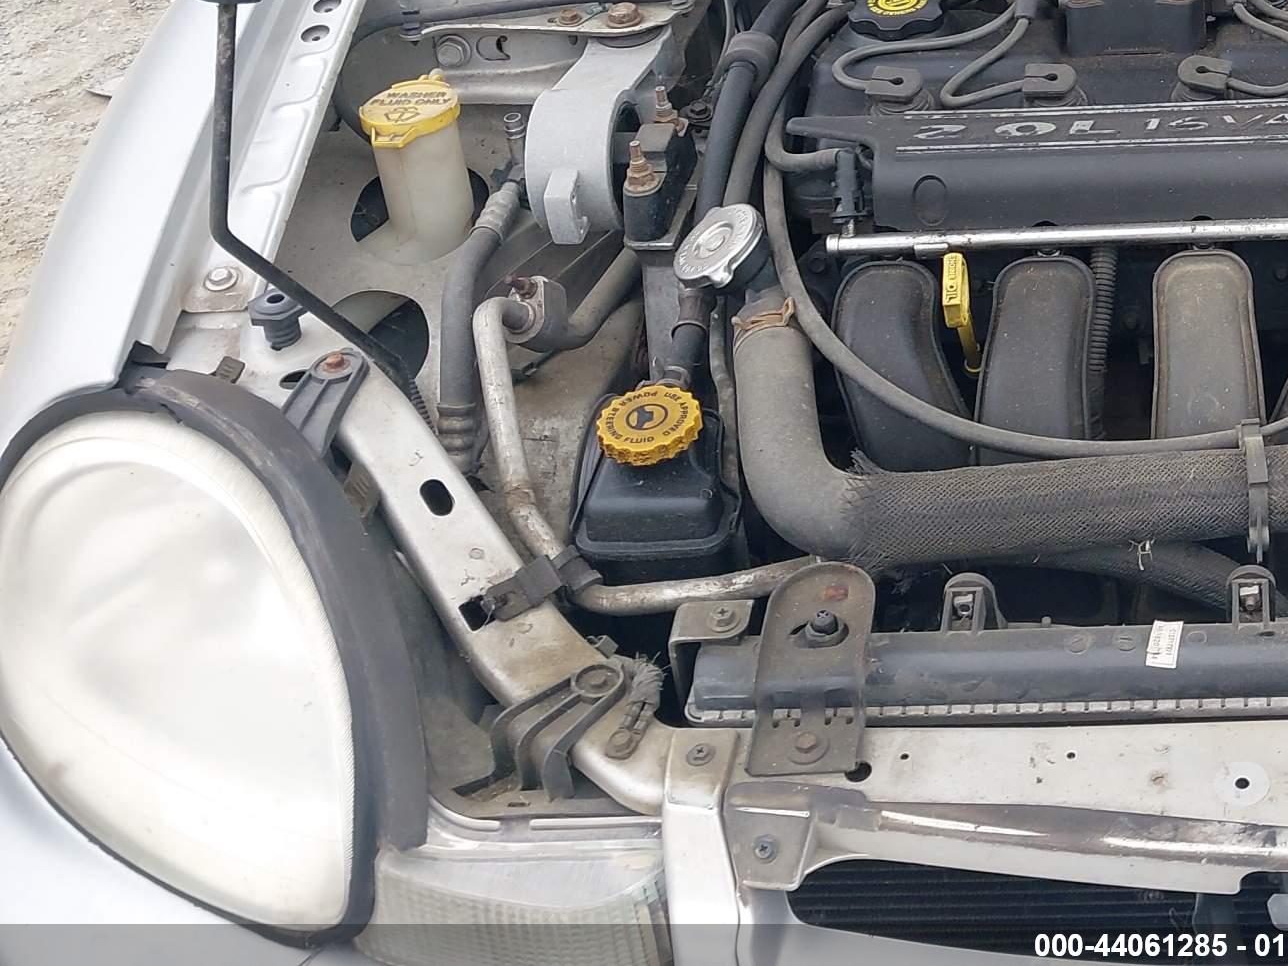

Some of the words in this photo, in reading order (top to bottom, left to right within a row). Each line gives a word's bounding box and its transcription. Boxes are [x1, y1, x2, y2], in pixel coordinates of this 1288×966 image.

[386, 90, 448, 99] WASHER
[369, 97, 413, 106] FLUID
[414, 97, 452, 106] ONLY
[619, 390, 660, 408] POWER
[663, 391, 682, 403] USE
[605, 406, 624, 441] STEERING
[662, 398, 690, 437] APPROVED
[622, 436, 656, 444] FLUID
